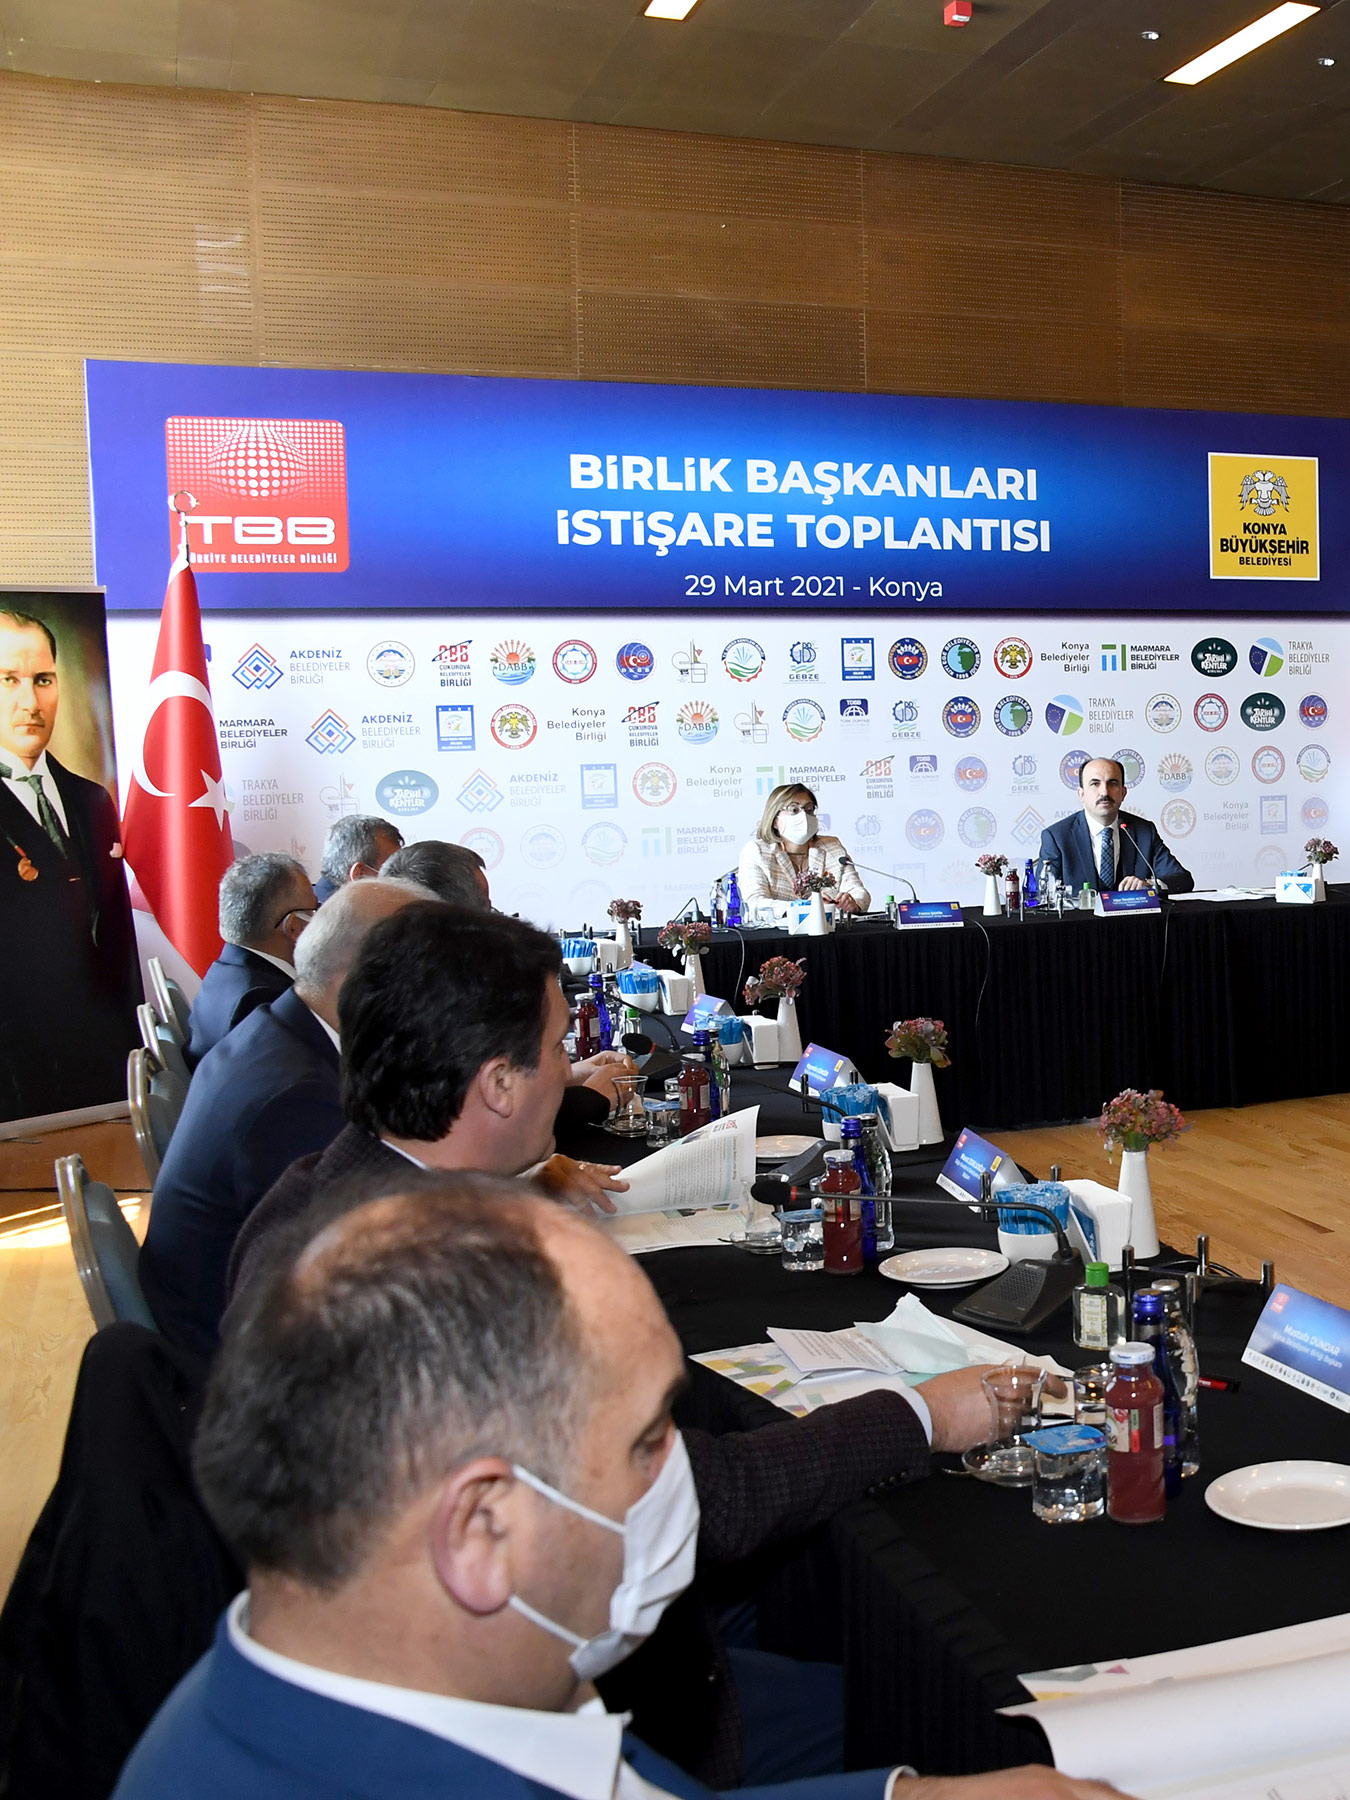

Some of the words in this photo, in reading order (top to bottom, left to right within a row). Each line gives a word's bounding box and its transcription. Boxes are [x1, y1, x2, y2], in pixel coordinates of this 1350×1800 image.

[569, 453, 733, 493] BİRLİK
[746, 459, 1038, 505] BAŞKANLARI
[185, 516, 335, 545] TBB
[556, 509, 775, 557] İSTİŞARE
[787, 513, 1051, 553] TOPLANTISI
[1243, 522, 1287, 535] KONYA
[1220, 535, 1309, 556] BÜYÜKŞEHİR
[189, 552, 226, 564] ÜRKİYE
[231, 552, 296, 564] BELEDİYELER
[300, 552, 337, 564] BİRLİĞİ
[1239, 555, 1291, 567] BELEDİYESİ
[684, 575, 717, 597] 29
[724, 576, 784, 597] Mart
[791, 576, 844, 597] 2021
[869, 577, 943, 601] Konya
[1061, 642, 1090, 652] Konya
[1288, 641, 1313, 650] TRAKYA
[290, 647, 343, 659] AKDENİZ
[1040, 653, 1090, 663] Belediyeler
[1130, 653, 1180, 661] BELEDİYELER
[1288, 652, 1330, 663] BELEDİYELER
[290, 660, 350, 672] BELEDİYELER
[499, 663, 527, 671] DABB
[1064, 664, 1090, 673] Birliği
[1131, 662, 1157, 670] BİRLİĞİ
[1201, 661, 1227, 670] KENTLER
[1288, 664, 1312, 675] BİRLİĞİ
[290, 673, 324, 684] BİRLİĞİ
[440, 677, 472, 687] BİRLİĞİ
[1089, 698, 1115, 708] TRAKYA
[361, 712, 413, 724] AKDENİZ
[572, 708, 606, 718] Konya
[1089, 709, 1134, 720] BELEDİYELER
[219, 718, 275, 728] MARMARA
[1250, 715, 1275, 724] KENTLER
[547, 720, 606, 730] Belediyeler
[684, 723, 711, 731] DABB
[1089, 721, 1115, 733] BİRLİĞİ
[220, 728, 288, 739] BELEDİYELER
[362, 725, 421, 737] BELEDİYELER
[576, 732, 607, 742] Birliği
[220, 739, 257, 749] BİRLİĞİ
[362, 737, 395, 749] BİRLİĞİ
[630, 738, 659, 747] BİRLİĞİ
[710, 765, 742, 775] Konya
[789, 766, 836, 774] MARMARA
[510, 771, 559, 783] AKDENİZ
[790, 774, 846, 784] BELEDİYELER
[1164, 773, 1187, 781] DABB
[242, 779, 279, 791] TRAKYA
[686, 777, 743, 788] Belediyeler
[510, 784, 566, 795] BELEDİYELER
[713, 789, 743, 799] Birliği
[867, 790, 894, 798] BİRLİĞİ
[243, 792, 304, 806] BELEDİYELER
[389, 797, 425, 809] KENTLER
[1222, 801, 1249, 810] Konya
[244, 807, 278, 822] BİRLİĞİ
[1203, 812, 1249, 821] Belediyeler
[677, 826, 725, 835] MARMARA
[1225, 822, 1249, 831] Birliği
[677, 835, 735, 845] BELEDİYELER
[1284, 1324, 1310, 1343] Mustafa
[1309, 1335, 1341, 1357] DÜNDAR
